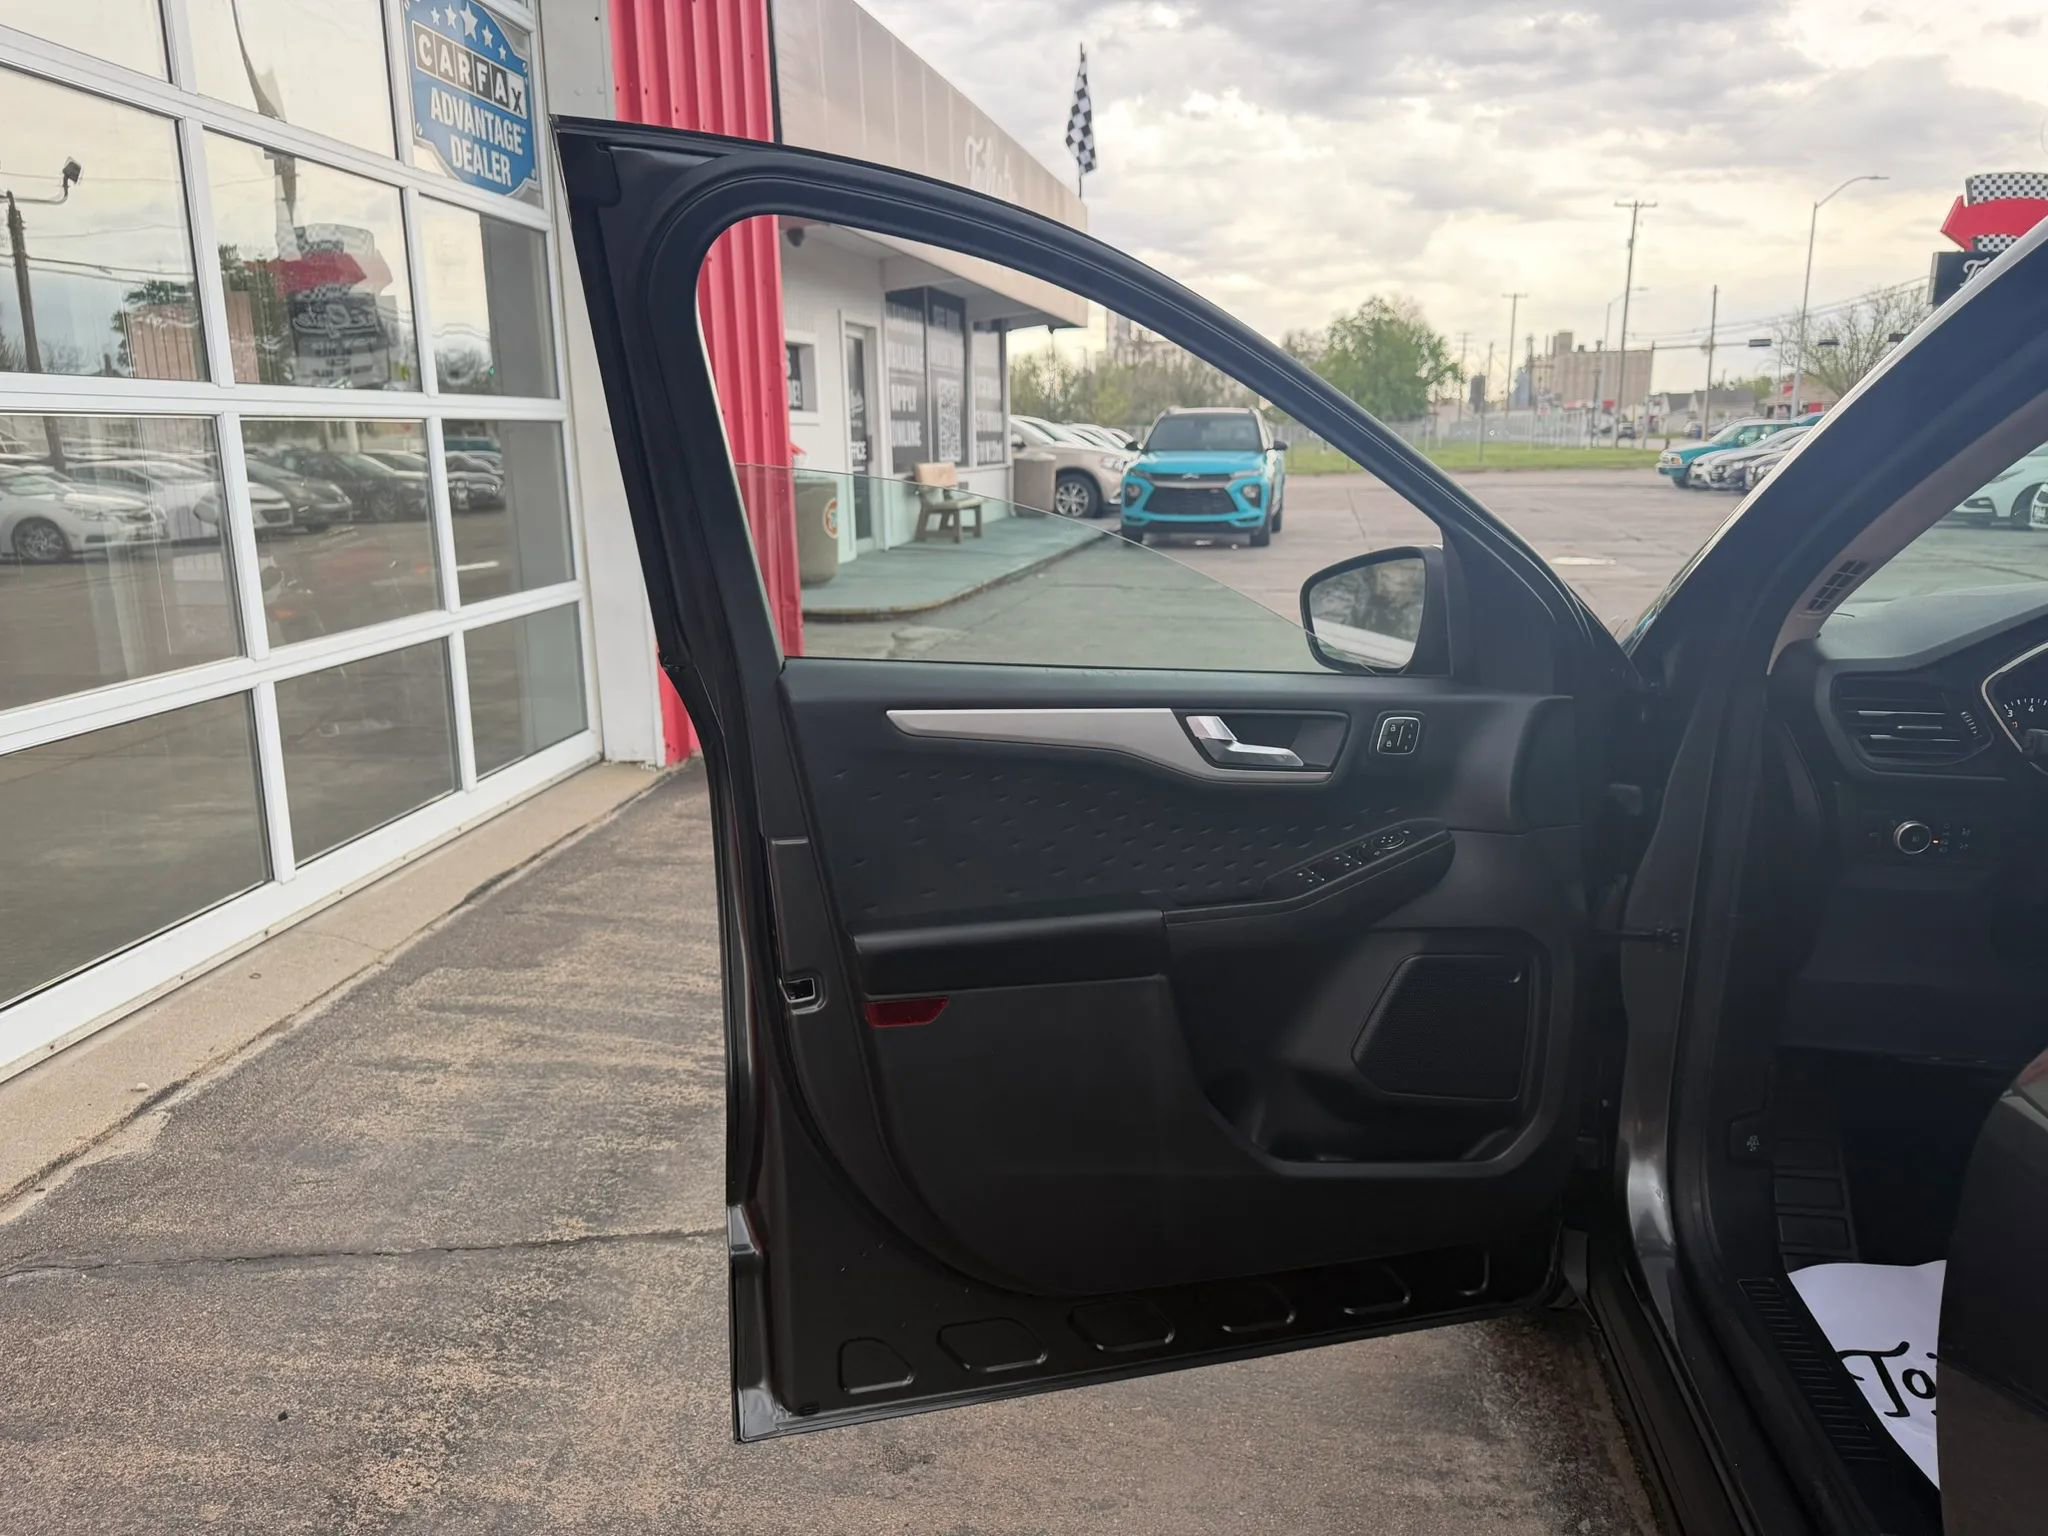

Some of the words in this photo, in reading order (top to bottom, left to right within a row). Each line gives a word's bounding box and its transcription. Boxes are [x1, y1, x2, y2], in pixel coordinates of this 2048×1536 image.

[418, 33, 524, 115] CARFAX
[430, 87, 524, 156] ADVANTAGE
[450, 134, 512, 187] DEALER
